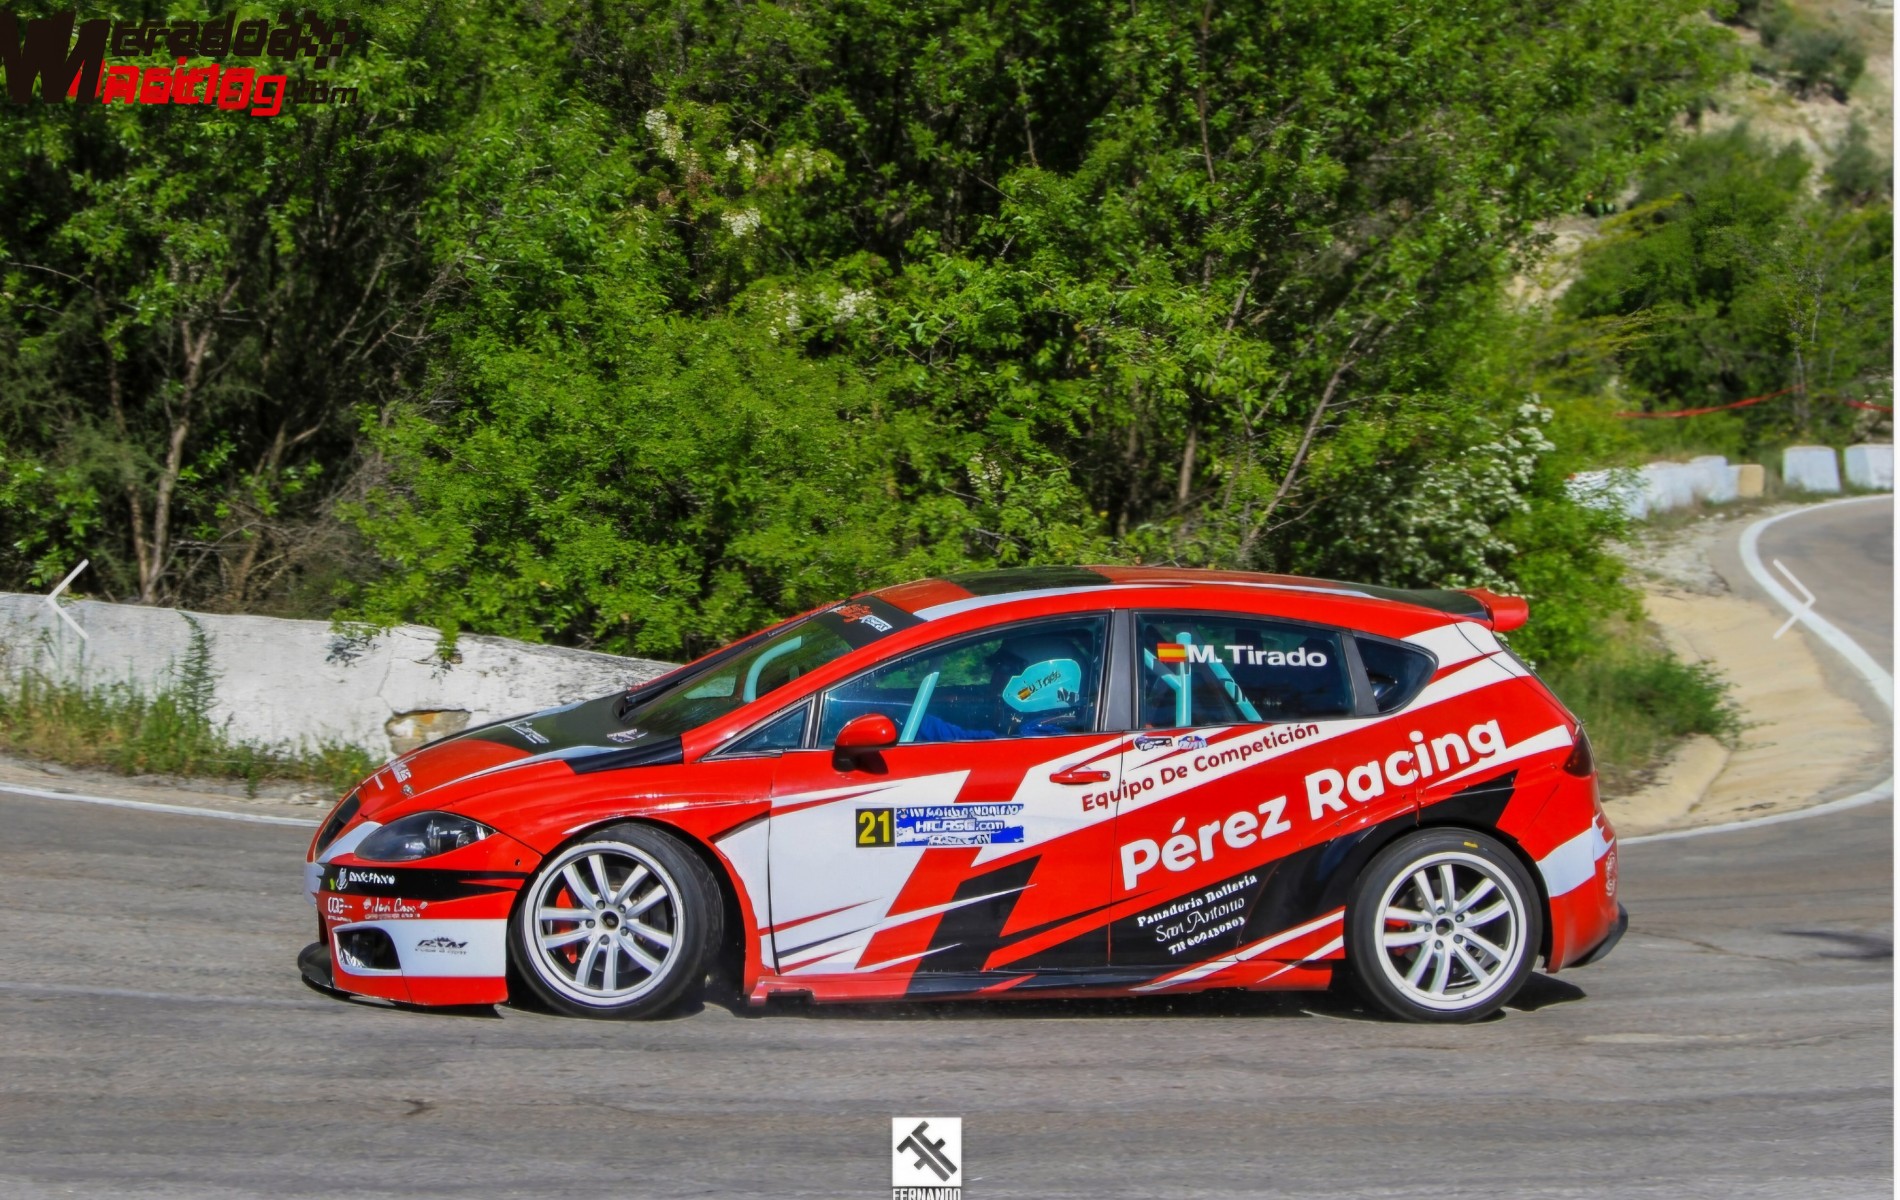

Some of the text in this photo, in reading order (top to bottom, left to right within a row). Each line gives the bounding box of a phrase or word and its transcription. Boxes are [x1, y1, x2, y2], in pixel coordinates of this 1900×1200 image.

[1081, 775, 1154, 812] Equipo
[1160, 766, 1188, 785] De
[1193, 724, 1319, 772] Competición
[858, 810, 890, 844] 21
[1119, 719, 1508, 891] Pérez Racing
[1155, 897, 1244, 942] San Antonio
